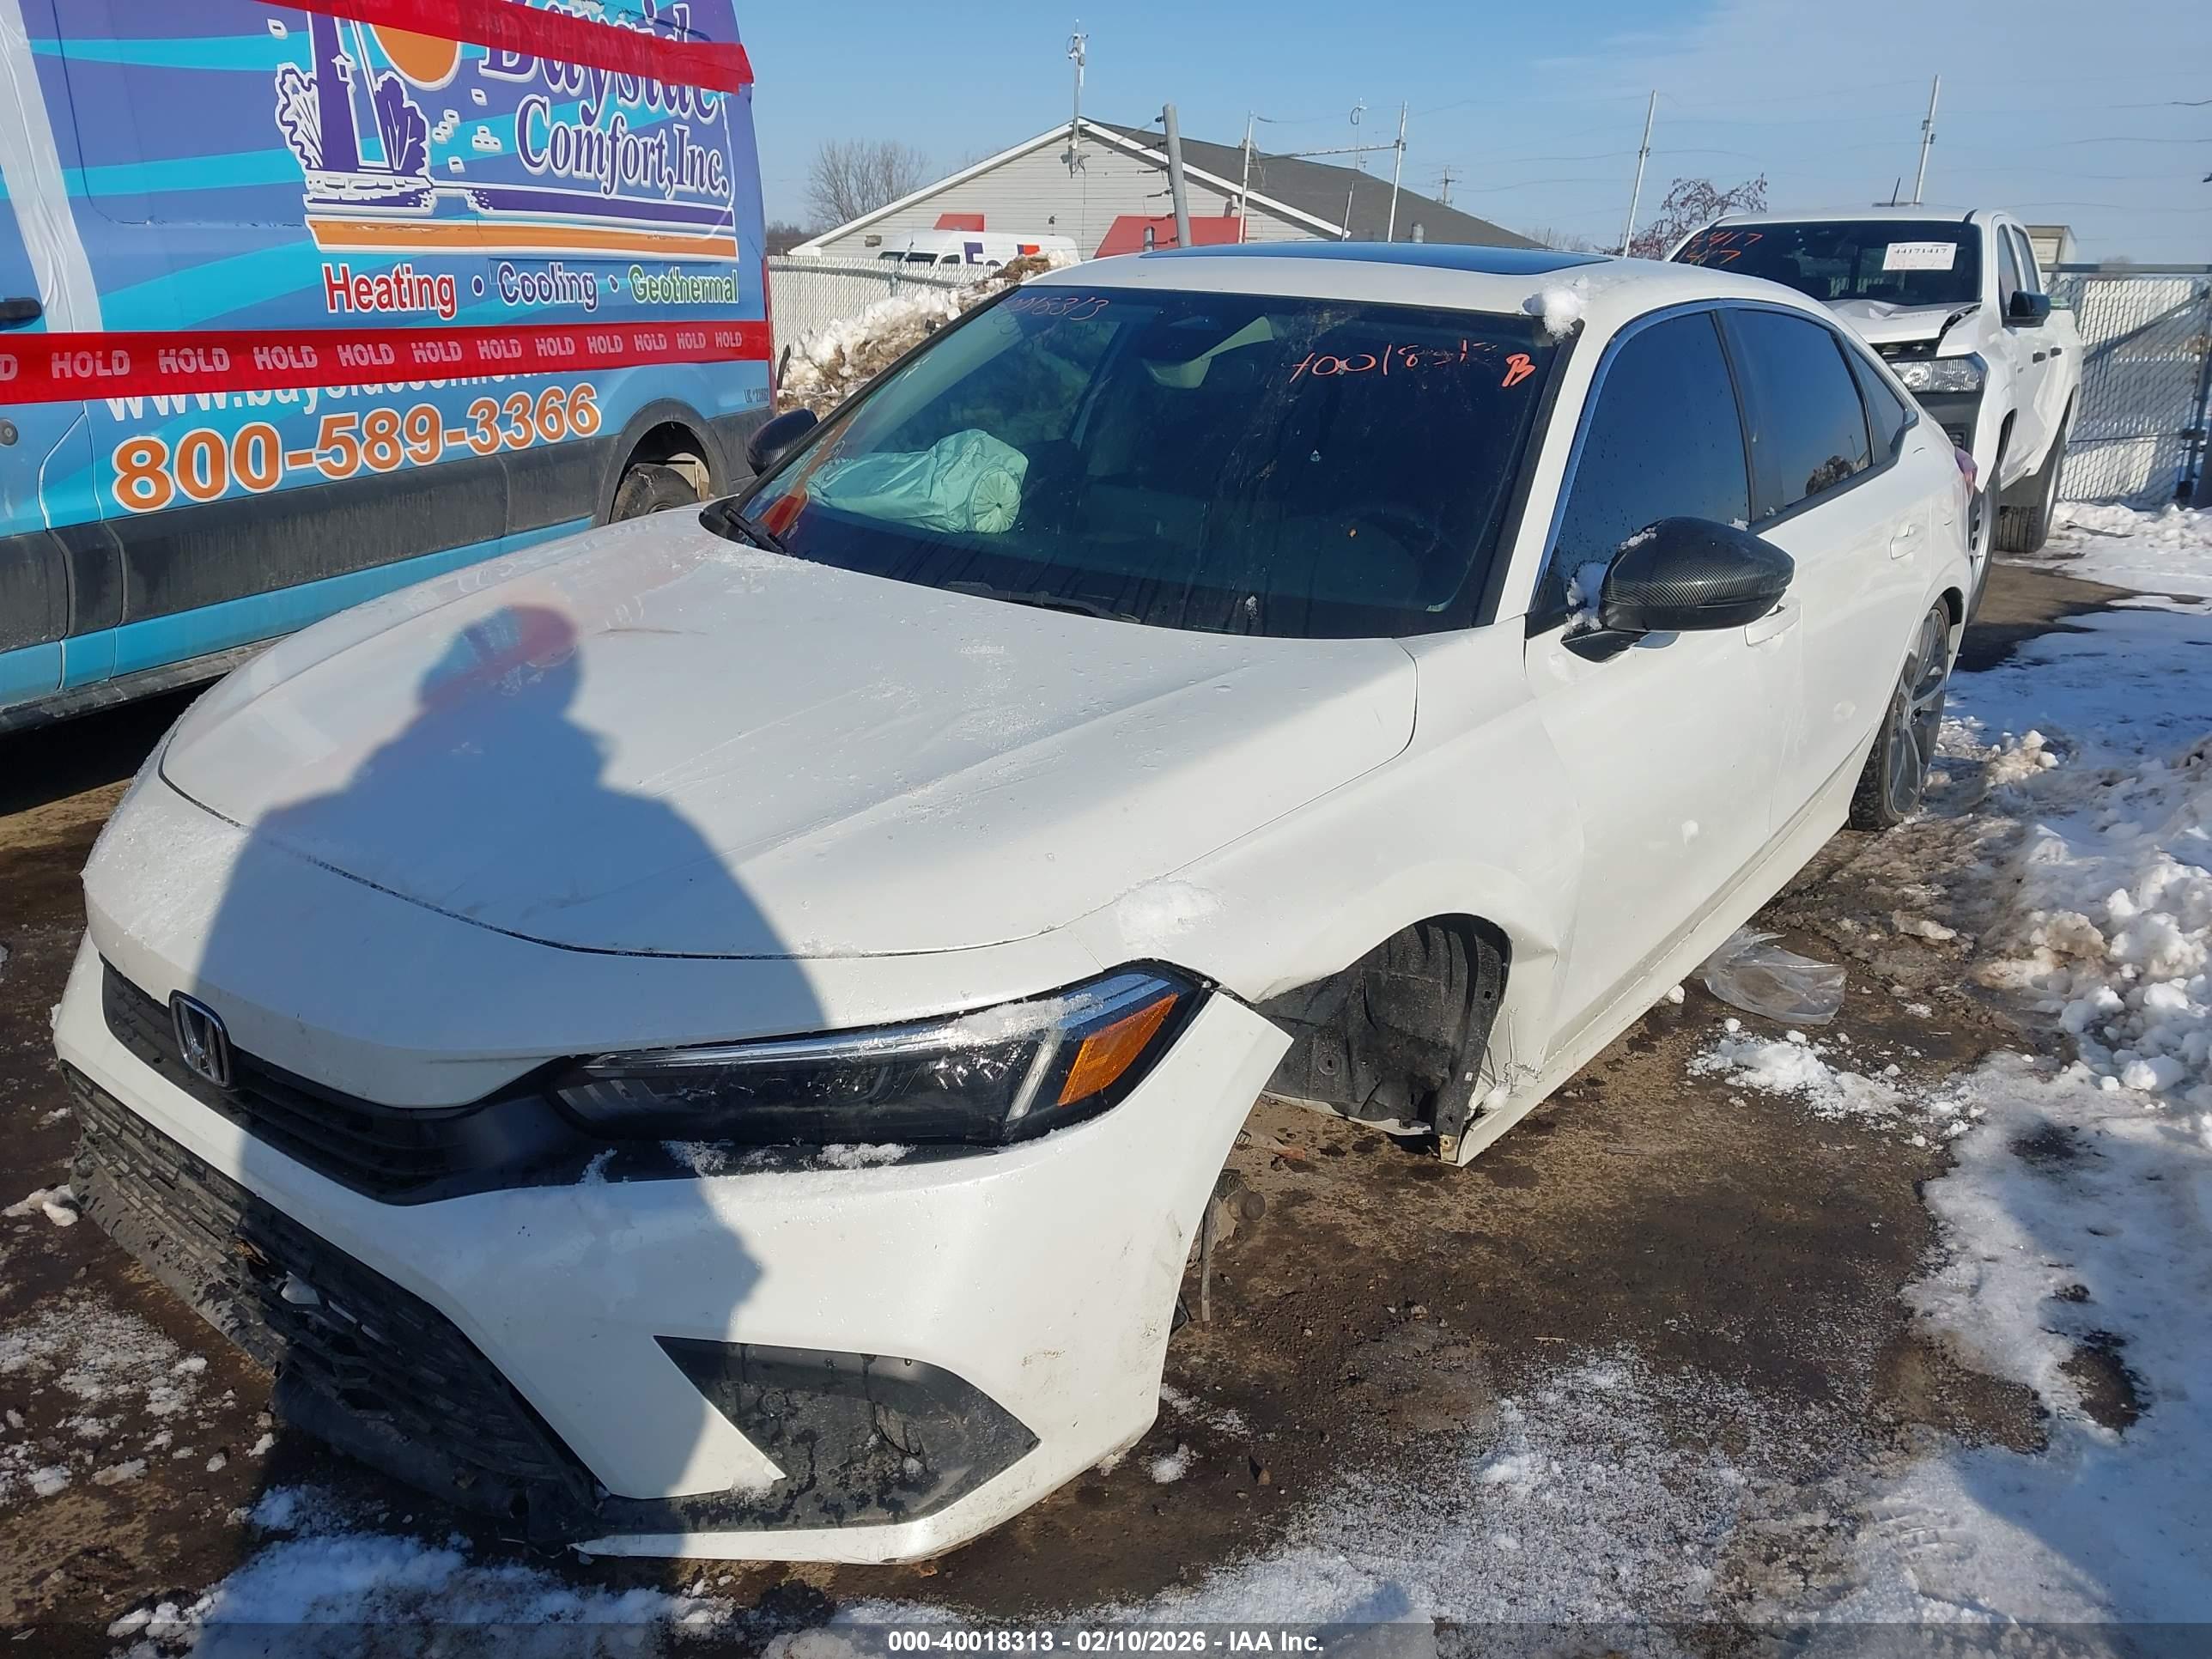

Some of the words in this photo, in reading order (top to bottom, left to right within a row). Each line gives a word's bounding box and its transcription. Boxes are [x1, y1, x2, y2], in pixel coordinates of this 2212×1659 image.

[322, 262, 457, 320] Heating
[497, 262, 598, 312] Cooling
[627, 264, 738, 304] Geothermal
[52, 349, 131, 379] HOLD
[159, 347, 230, 374] HOLD
[254, 344, 318, 370] HOLD
[337, 343, 396, 367] HOLD
[413, 341, 463, 364] HOLD
[477, 338, 522, 361] HOLD
[535, 336, 575, 357] HOLD
[586, 334, 623, 355] HOLD
[634, 333, 667, 352] HOLD
[676, 332, 707, 350] HOLD
[714, 331, 743, 349] HOLD
[112, 382, 602, 514] 800-589-3366
